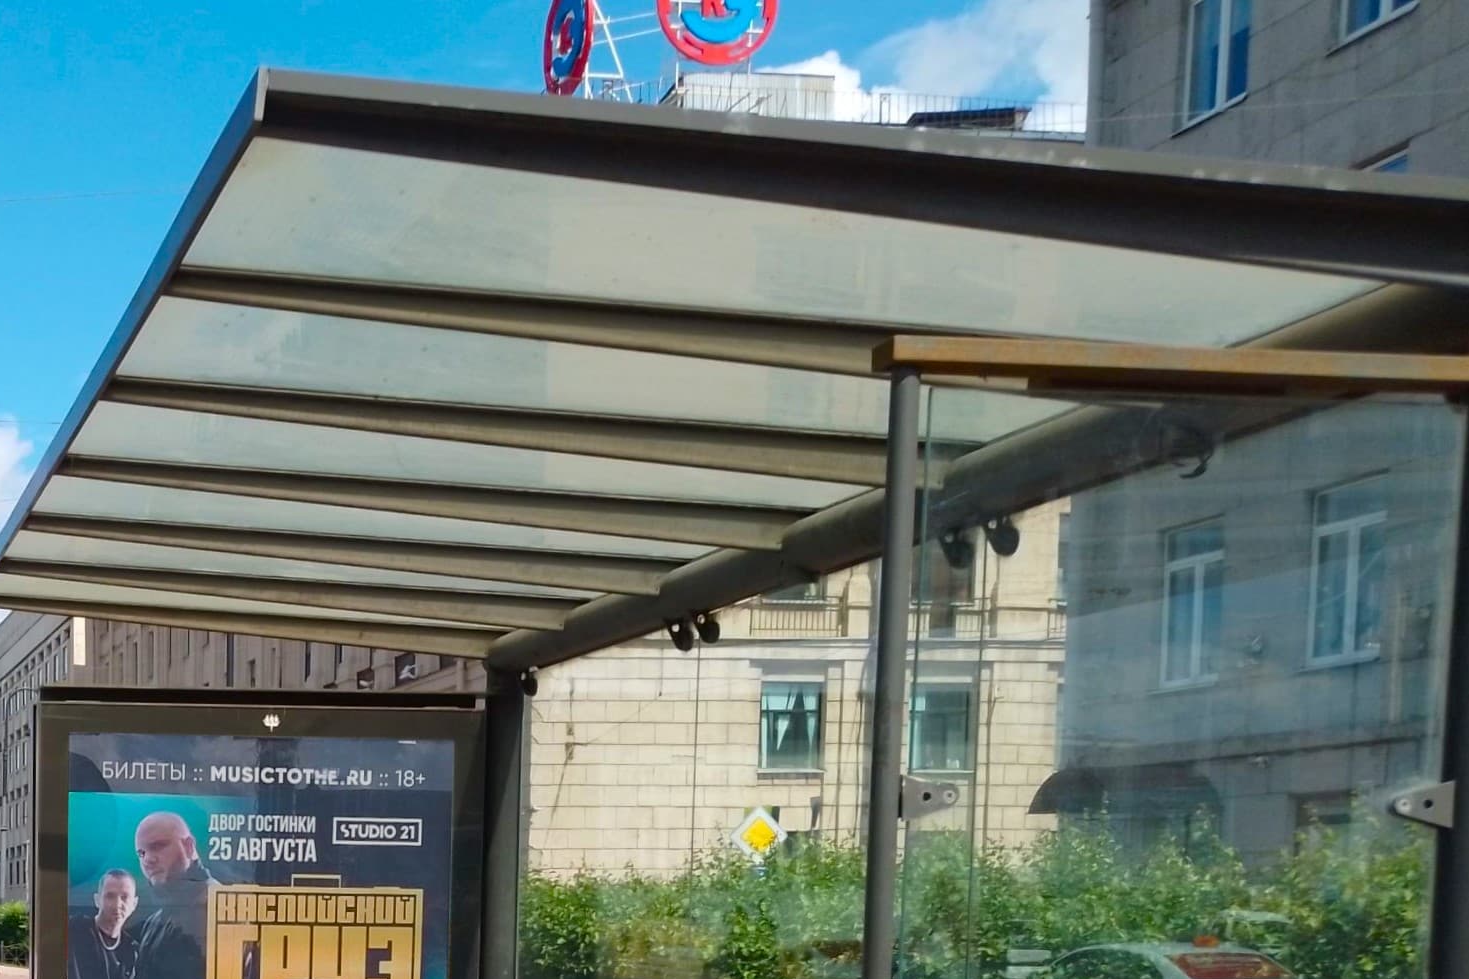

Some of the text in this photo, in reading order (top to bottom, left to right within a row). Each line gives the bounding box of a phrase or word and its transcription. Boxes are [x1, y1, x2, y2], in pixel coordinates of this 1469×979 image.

[102, 760, 186, 781] БИЛЕТЫ
[210, 764, 373, 787] MUSICTOTHE.RU
[395, 769, 426, 788] 18+
[208, 813, 317, 833] ДВОР ГОСТИНКИ
[339, 823, 415, 840] STUDIO 21
[208, 836, 317, 863] 25 АВГУСТА
[217, 893, 416, 925] КАСПИЙСКИЙ
